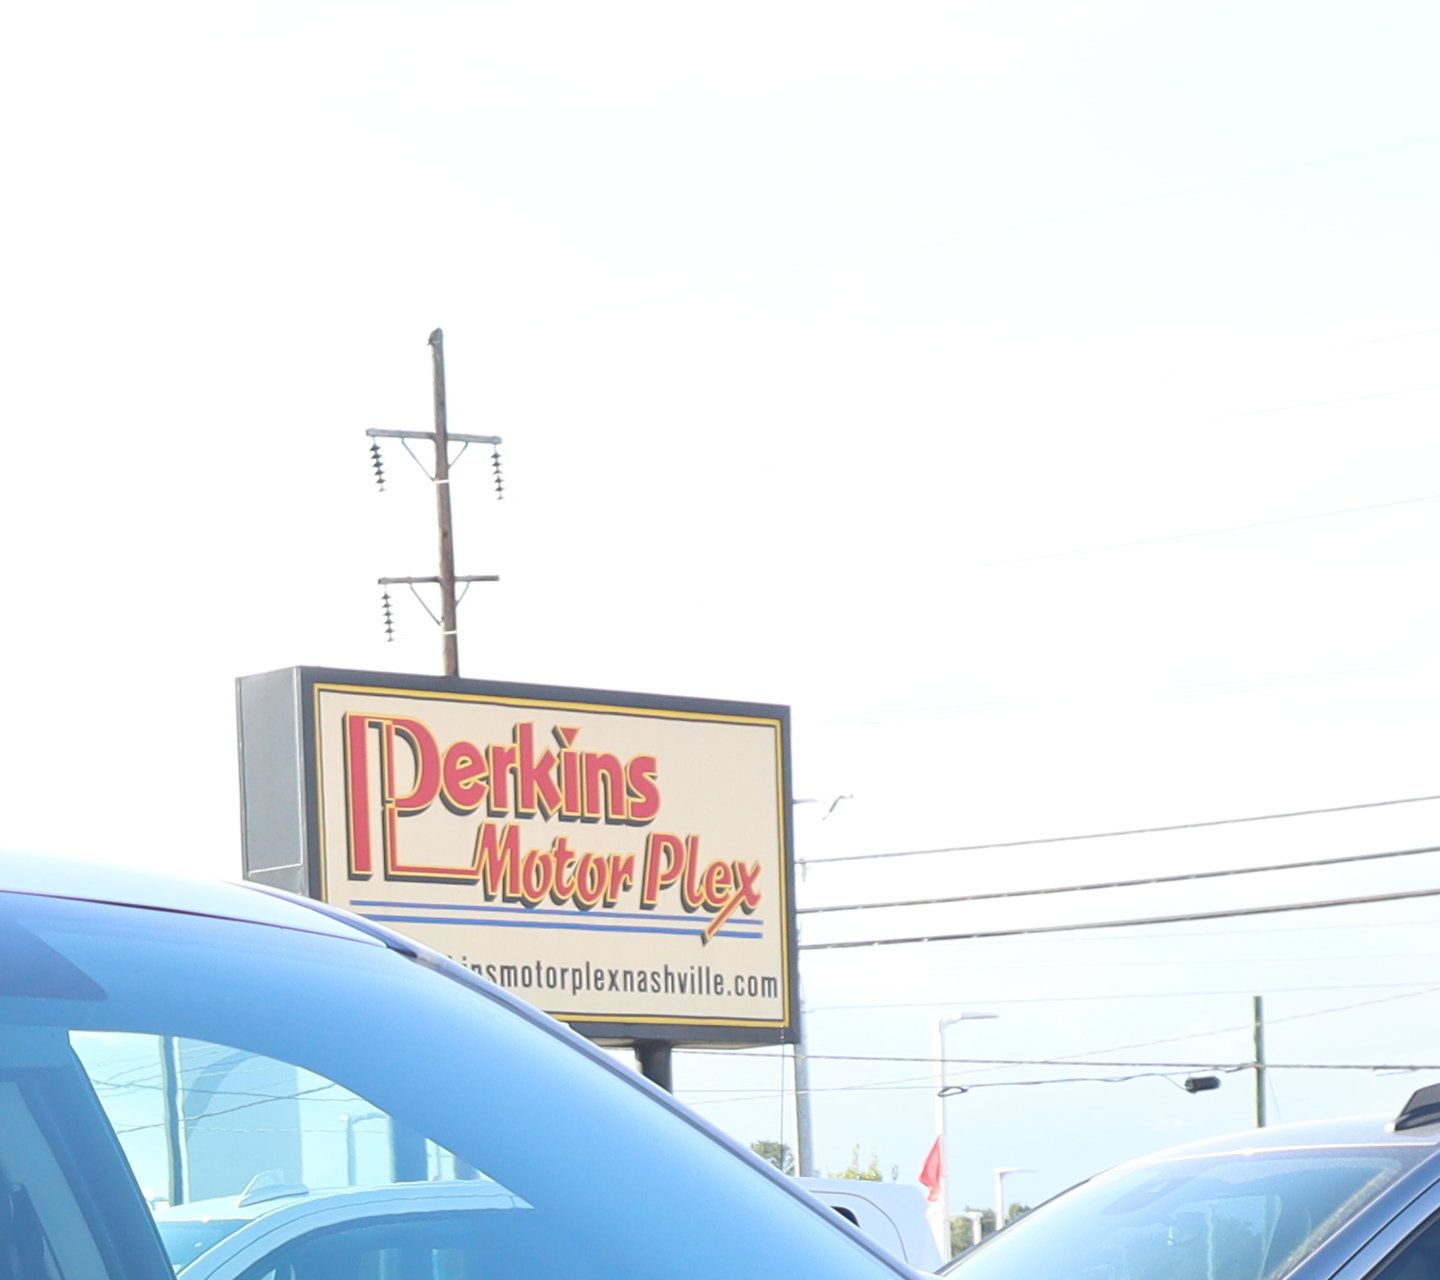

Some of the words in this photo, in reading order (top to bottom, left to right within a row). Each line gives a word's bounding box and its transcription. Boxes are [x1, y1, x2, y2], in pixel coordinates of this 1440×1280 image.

[343, 712, 661, 881] Perkins
[474, 821, 636, 911] Motor
[640, 832, 761, 944] Plex
